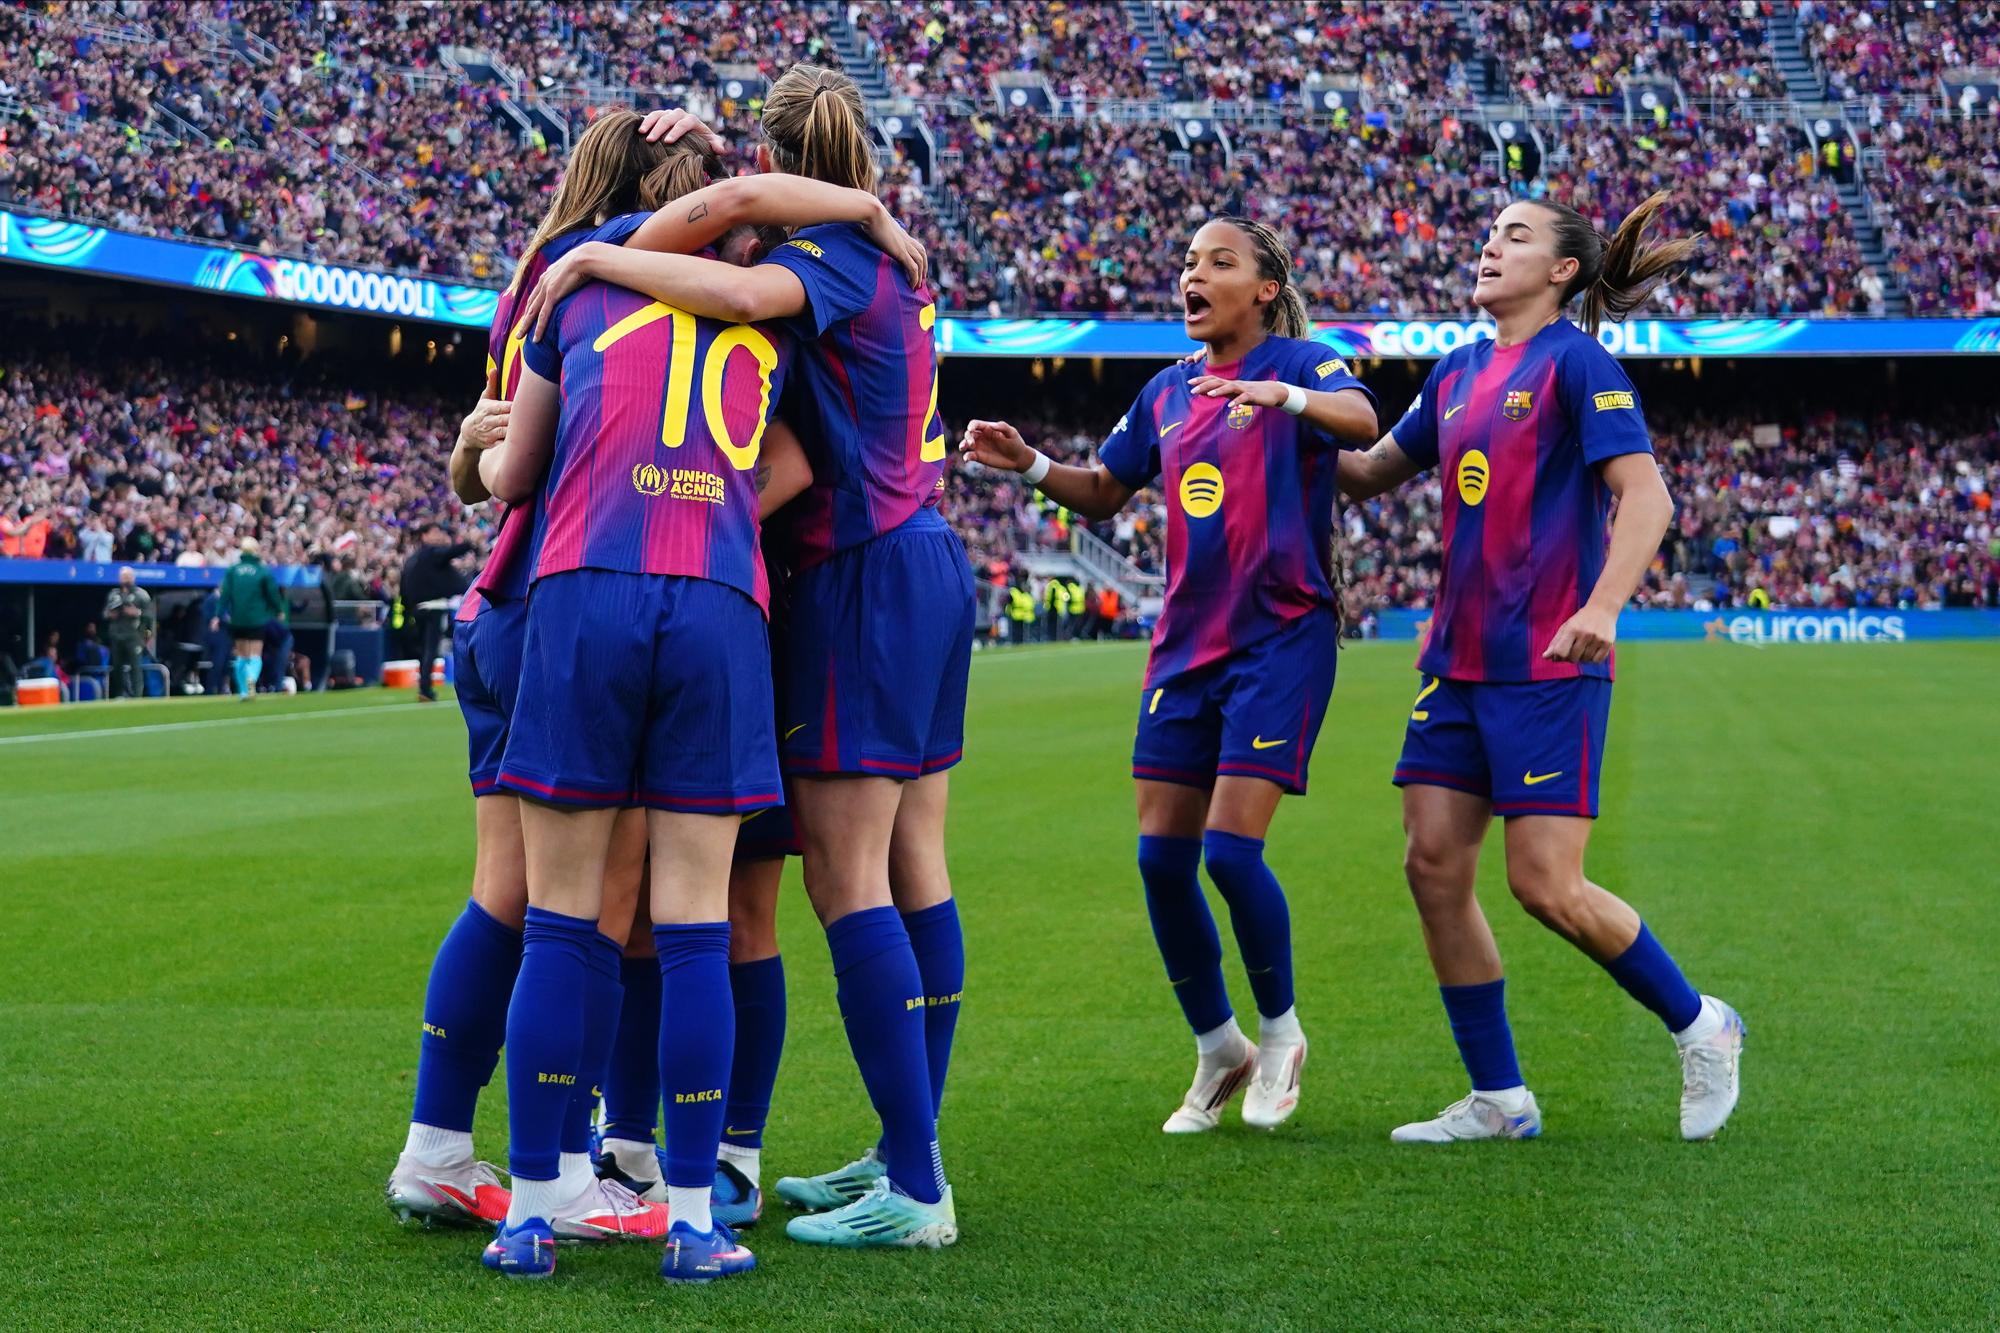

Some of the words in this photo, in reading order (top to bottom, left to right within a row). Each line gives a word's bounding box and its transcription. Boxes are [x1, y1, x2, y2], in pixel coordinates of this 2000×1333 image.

[275, 259, 434, 318] GOOOOOOOL!
[593, 301, 778, 470] 10
[1594, 394, 1634, 409] BIMBO
[672, 469, 724, 490] UNHCR
[670, 482, 725, 501] ACNUR
[1729, 607, 1905, 644] euronics
[675, 1089, 722, 1104] BARÇA
